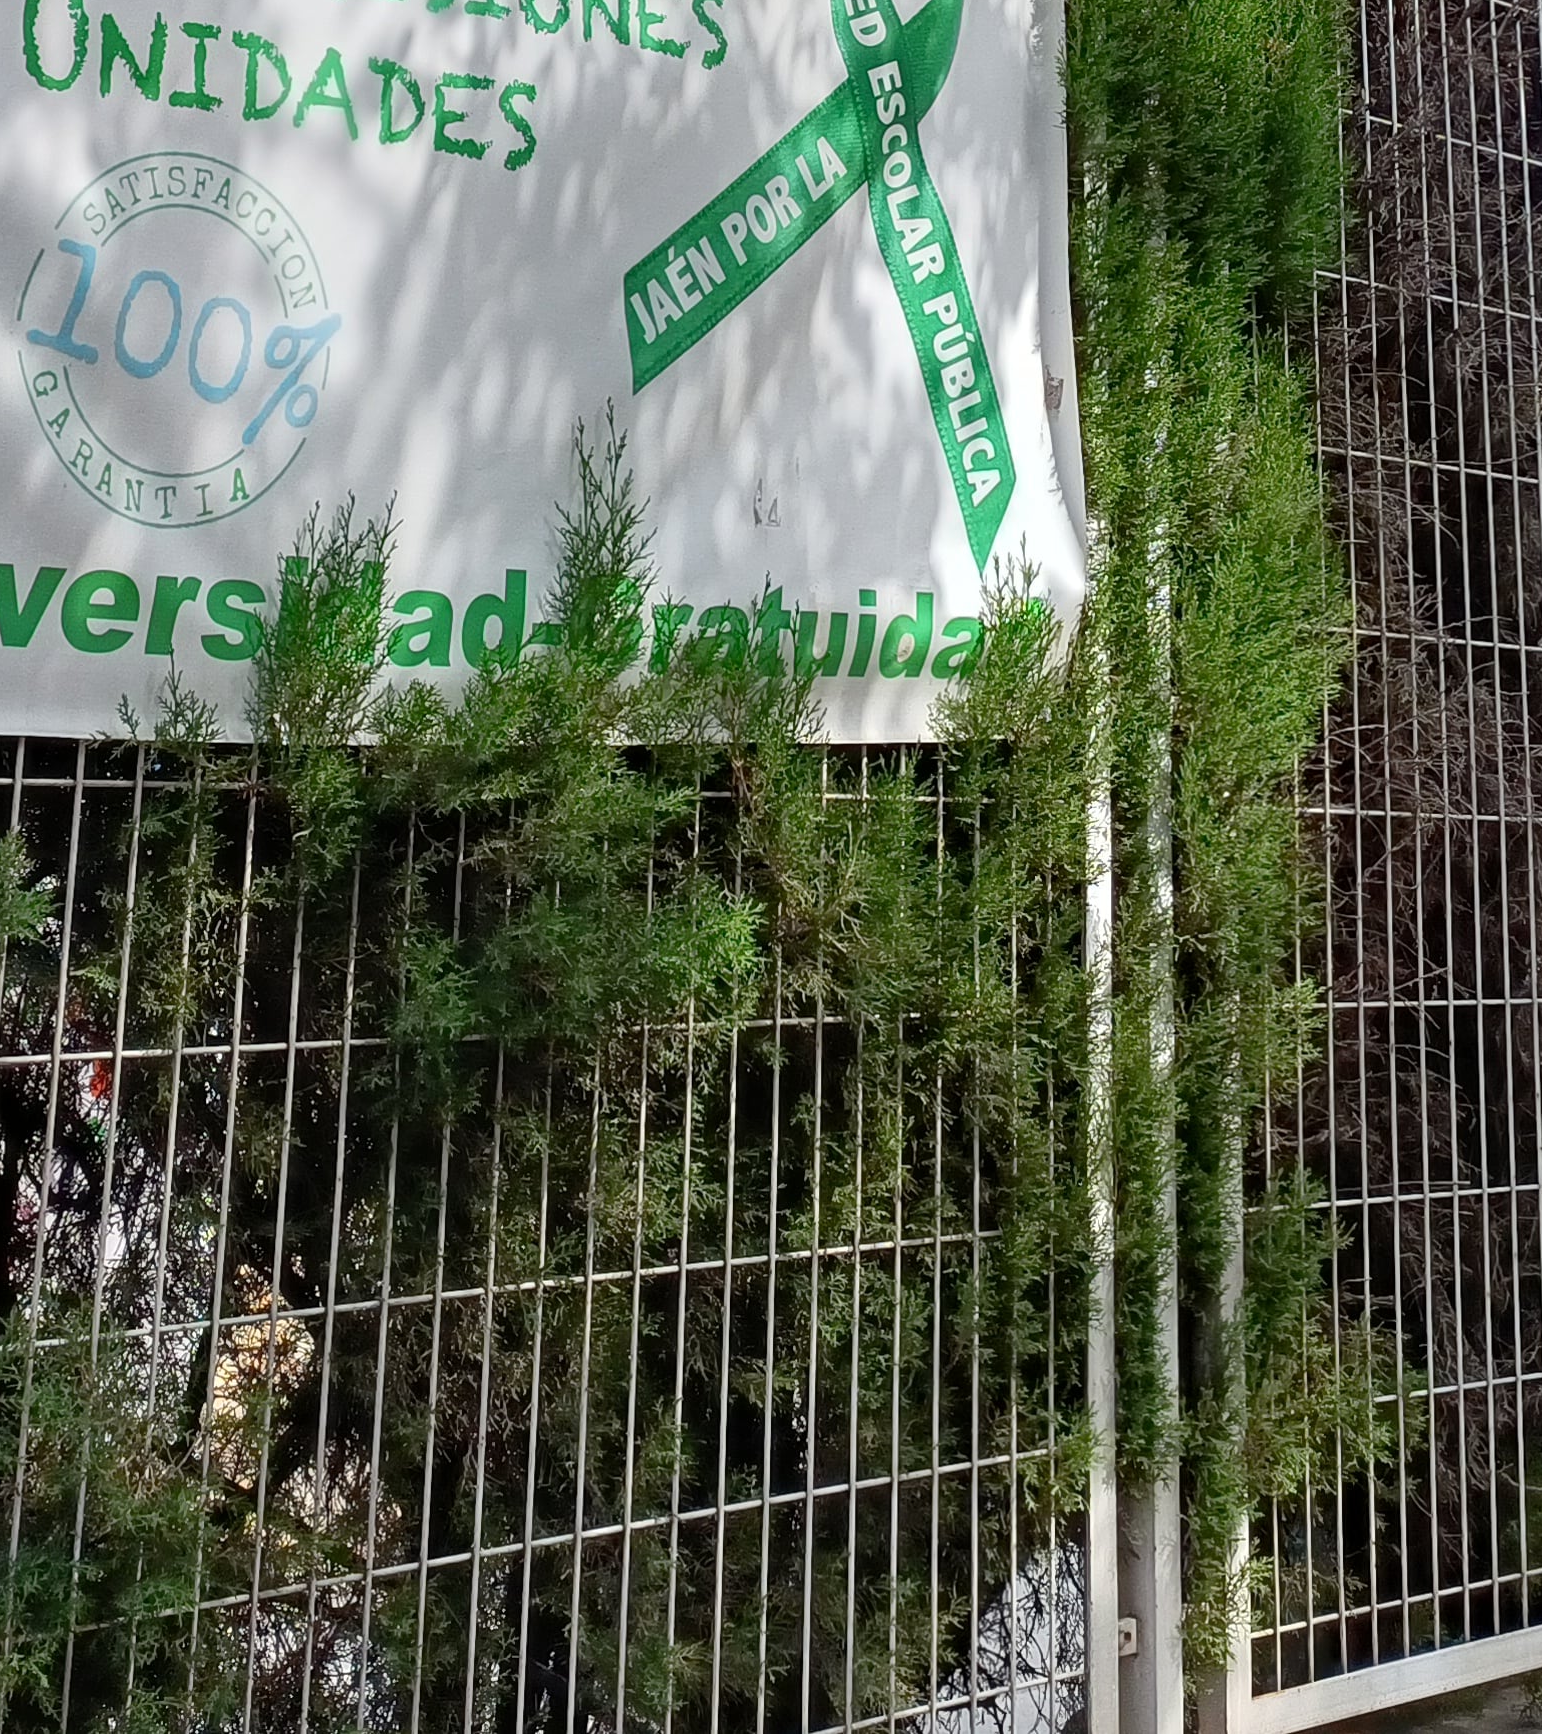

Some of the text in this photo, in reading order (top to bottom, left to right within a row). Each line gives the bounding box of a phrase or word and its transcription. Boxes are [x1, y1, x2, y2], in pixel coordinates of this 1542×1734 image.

[83, 166, 317, 309] SATISFACCION
[629, 135, 849, 345] JAÉN POR LA
[870, 61, 946, 285] ESCOLAR
[923, 297, 1006, 508] PÚBLICA
[26, 238, 342, 446] 100%
[33, 370, 250, 520] GARANTIA
